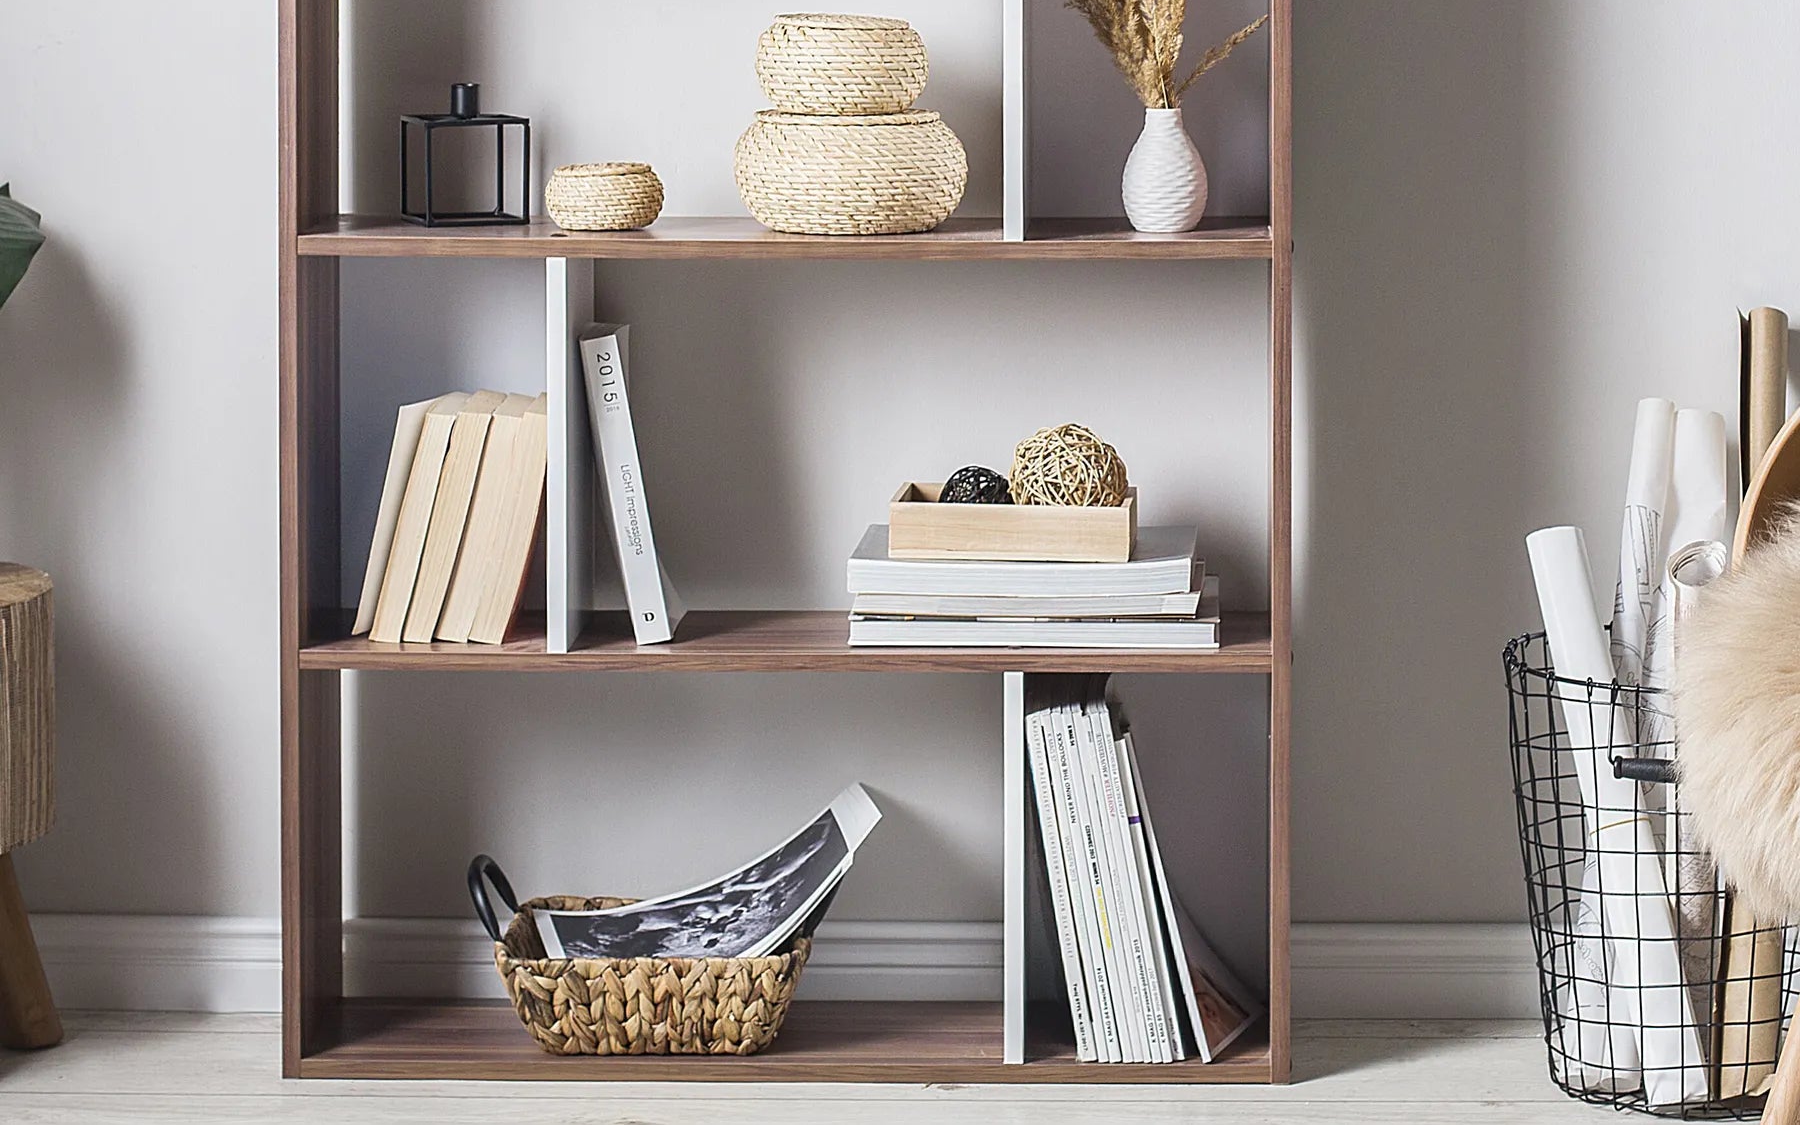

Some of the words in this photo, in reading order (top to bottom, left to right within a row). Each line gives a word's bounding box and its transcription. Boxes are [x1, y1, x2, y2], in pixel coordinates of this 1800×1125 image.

[597, 352, 618, 402] 2015
[620, 464, 635, 493] LIGHT
[1056, 732, 1067, 767] BOLLOCKS
[1064, 782, 1073, 800] MIND
[1067, 801, 1077, 824] NEVER
[1096, 967, 1104, 983] 2014
[1105, 1020, 1113, 1037] MAG
[1148, 1022, 1156, 1037] MAG
